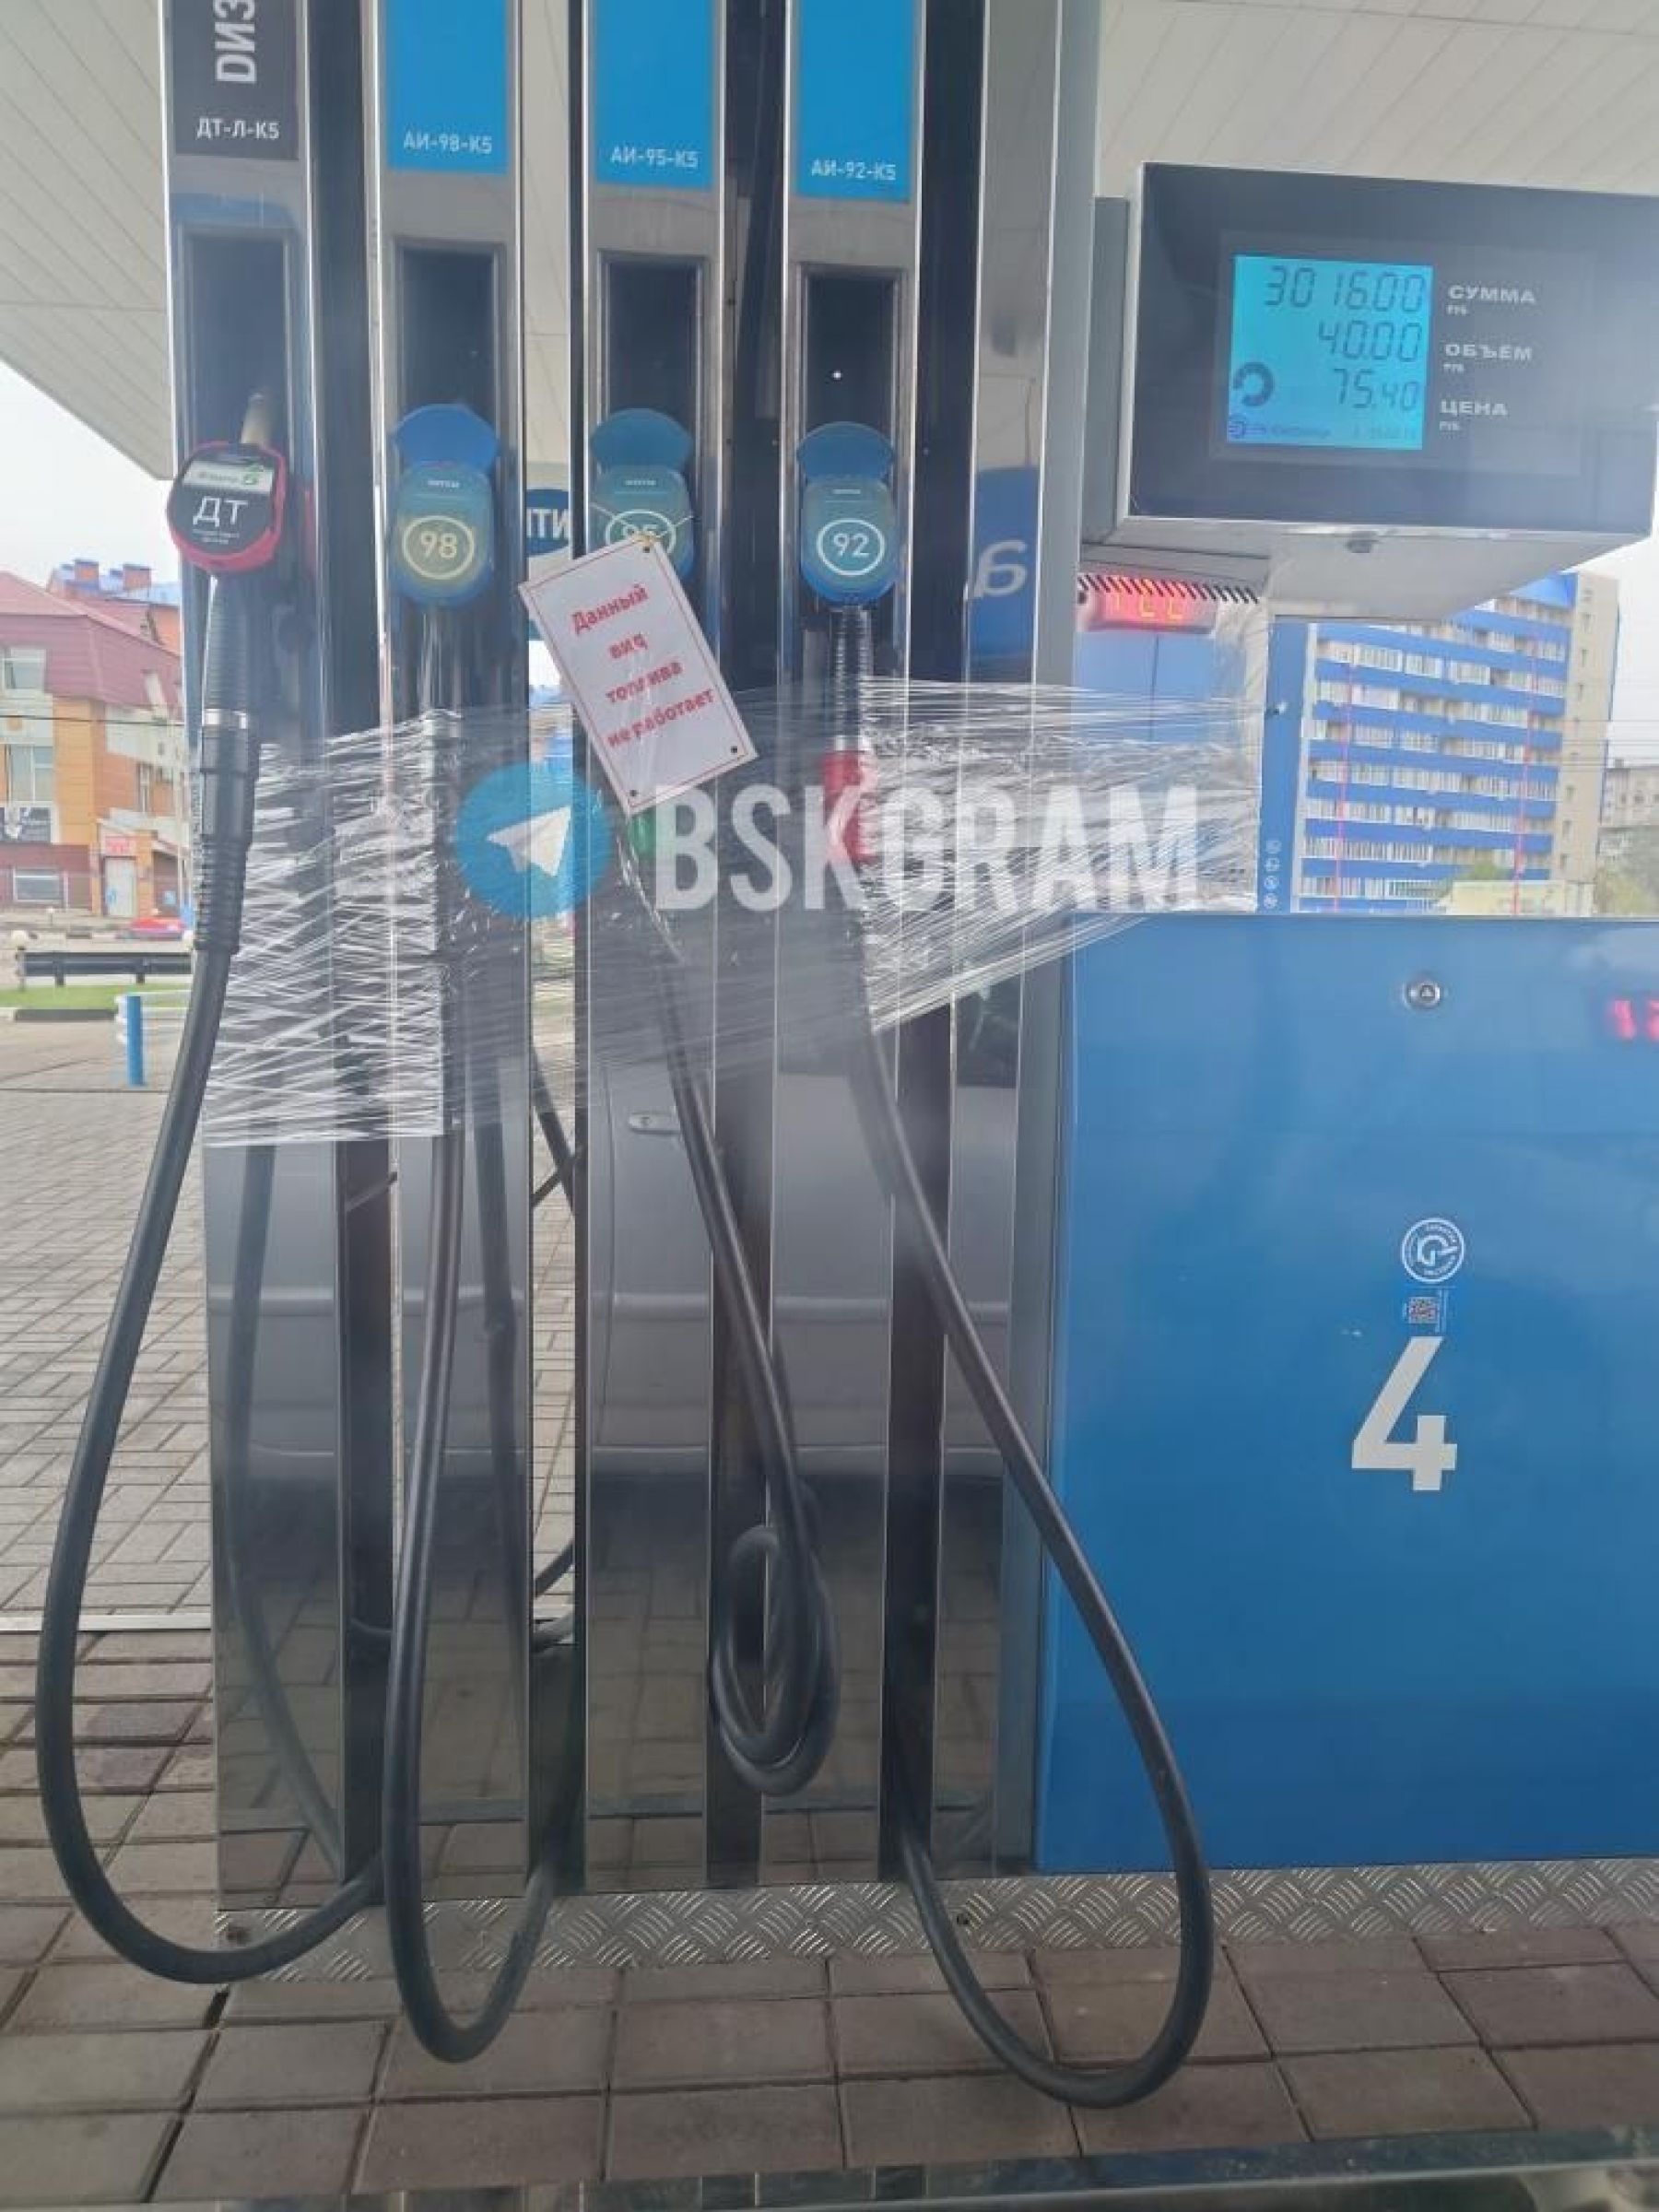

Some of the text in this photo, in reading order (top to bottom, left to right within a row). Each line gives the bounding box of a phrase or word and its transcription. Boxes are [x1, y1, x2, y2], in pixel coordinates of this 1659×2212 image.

[196, 117, 280, 140] ДТ-Л-К5
[403, 131, 494, 155] АИ-98-К5
[610, 146, 700, 170] АИ-95-К5
[810, 159, 896, 182] АИ-92-К5
[1448, 285, 1536, 304] СУММА
[1444, 344, 1534, 361] ОБЪЕМ
[1440, 399, 1509, 417] ЦЕНА
[192, 495, 250, 528] ДТ
[418, 531, 458, 559] 98
[832, 533, 871, 559] 92
[571, 583, 649, 635] Данный
[631, 689, 714, 740] работает
[1351, 1335, 1458, 1491] 4
